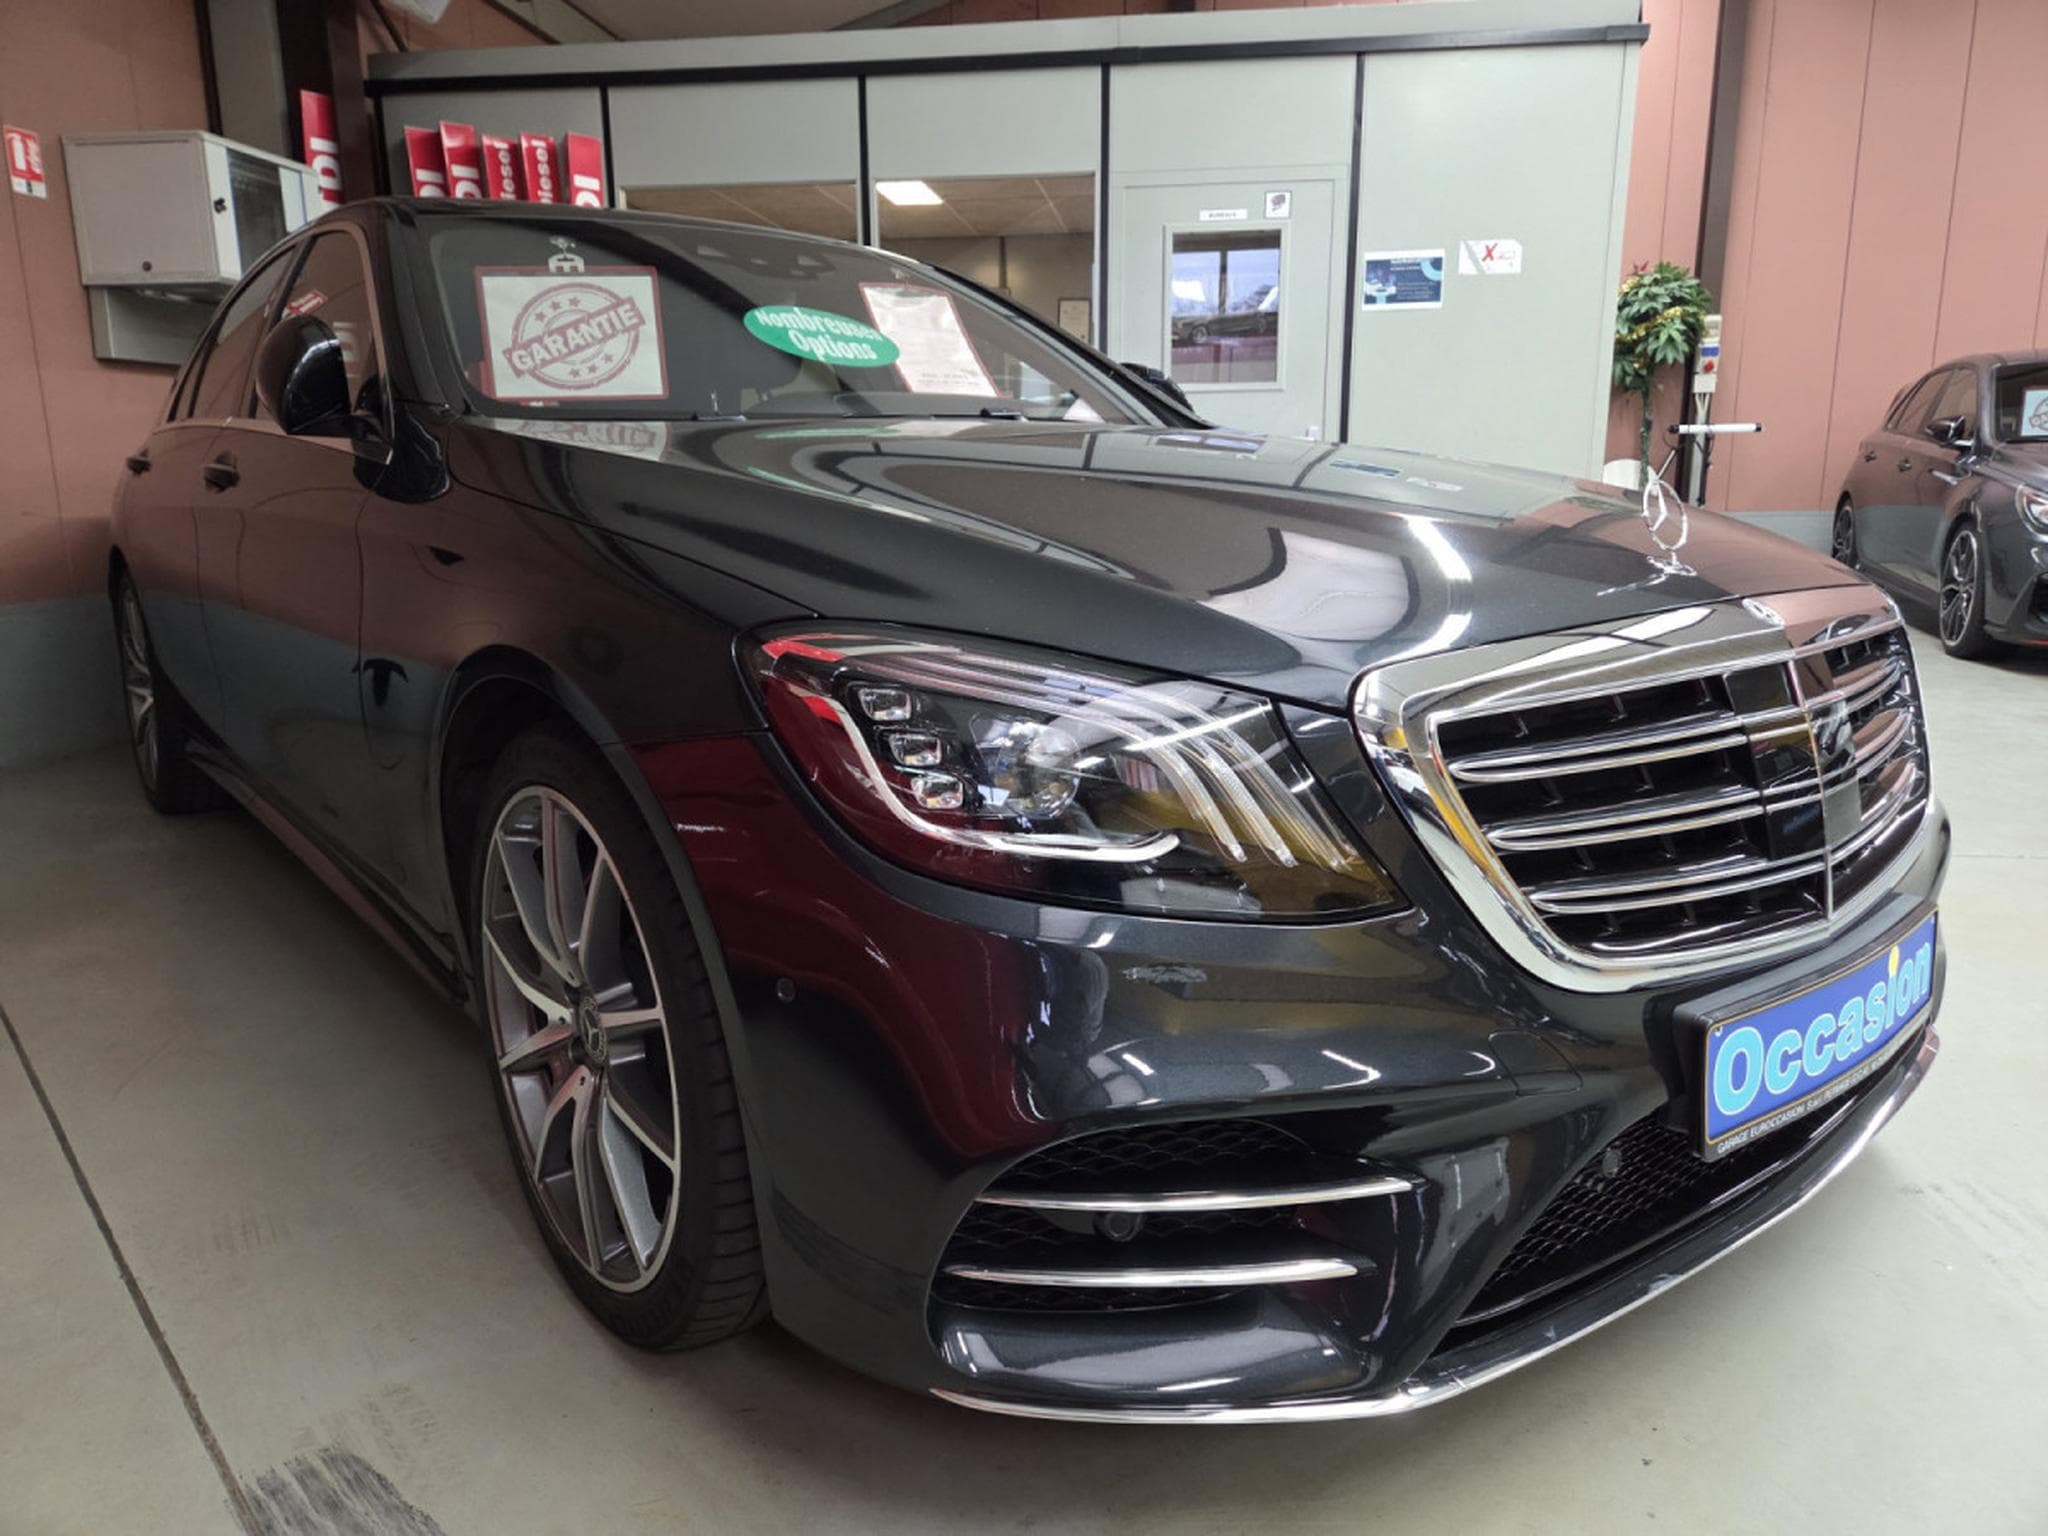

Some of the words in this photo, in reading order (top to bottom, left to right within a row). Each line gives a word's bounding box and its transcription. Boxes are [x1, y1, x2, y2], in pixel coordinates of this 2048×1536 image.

[510, 302, 640, 372] GARANTIE
[753, 306, 884, 342] Nombreuses
[787, 329, 878, 362] Options
[1713, 942, 1931, 1115] Occasion
[1716, 1129, 1749, 1155] GARAGE
